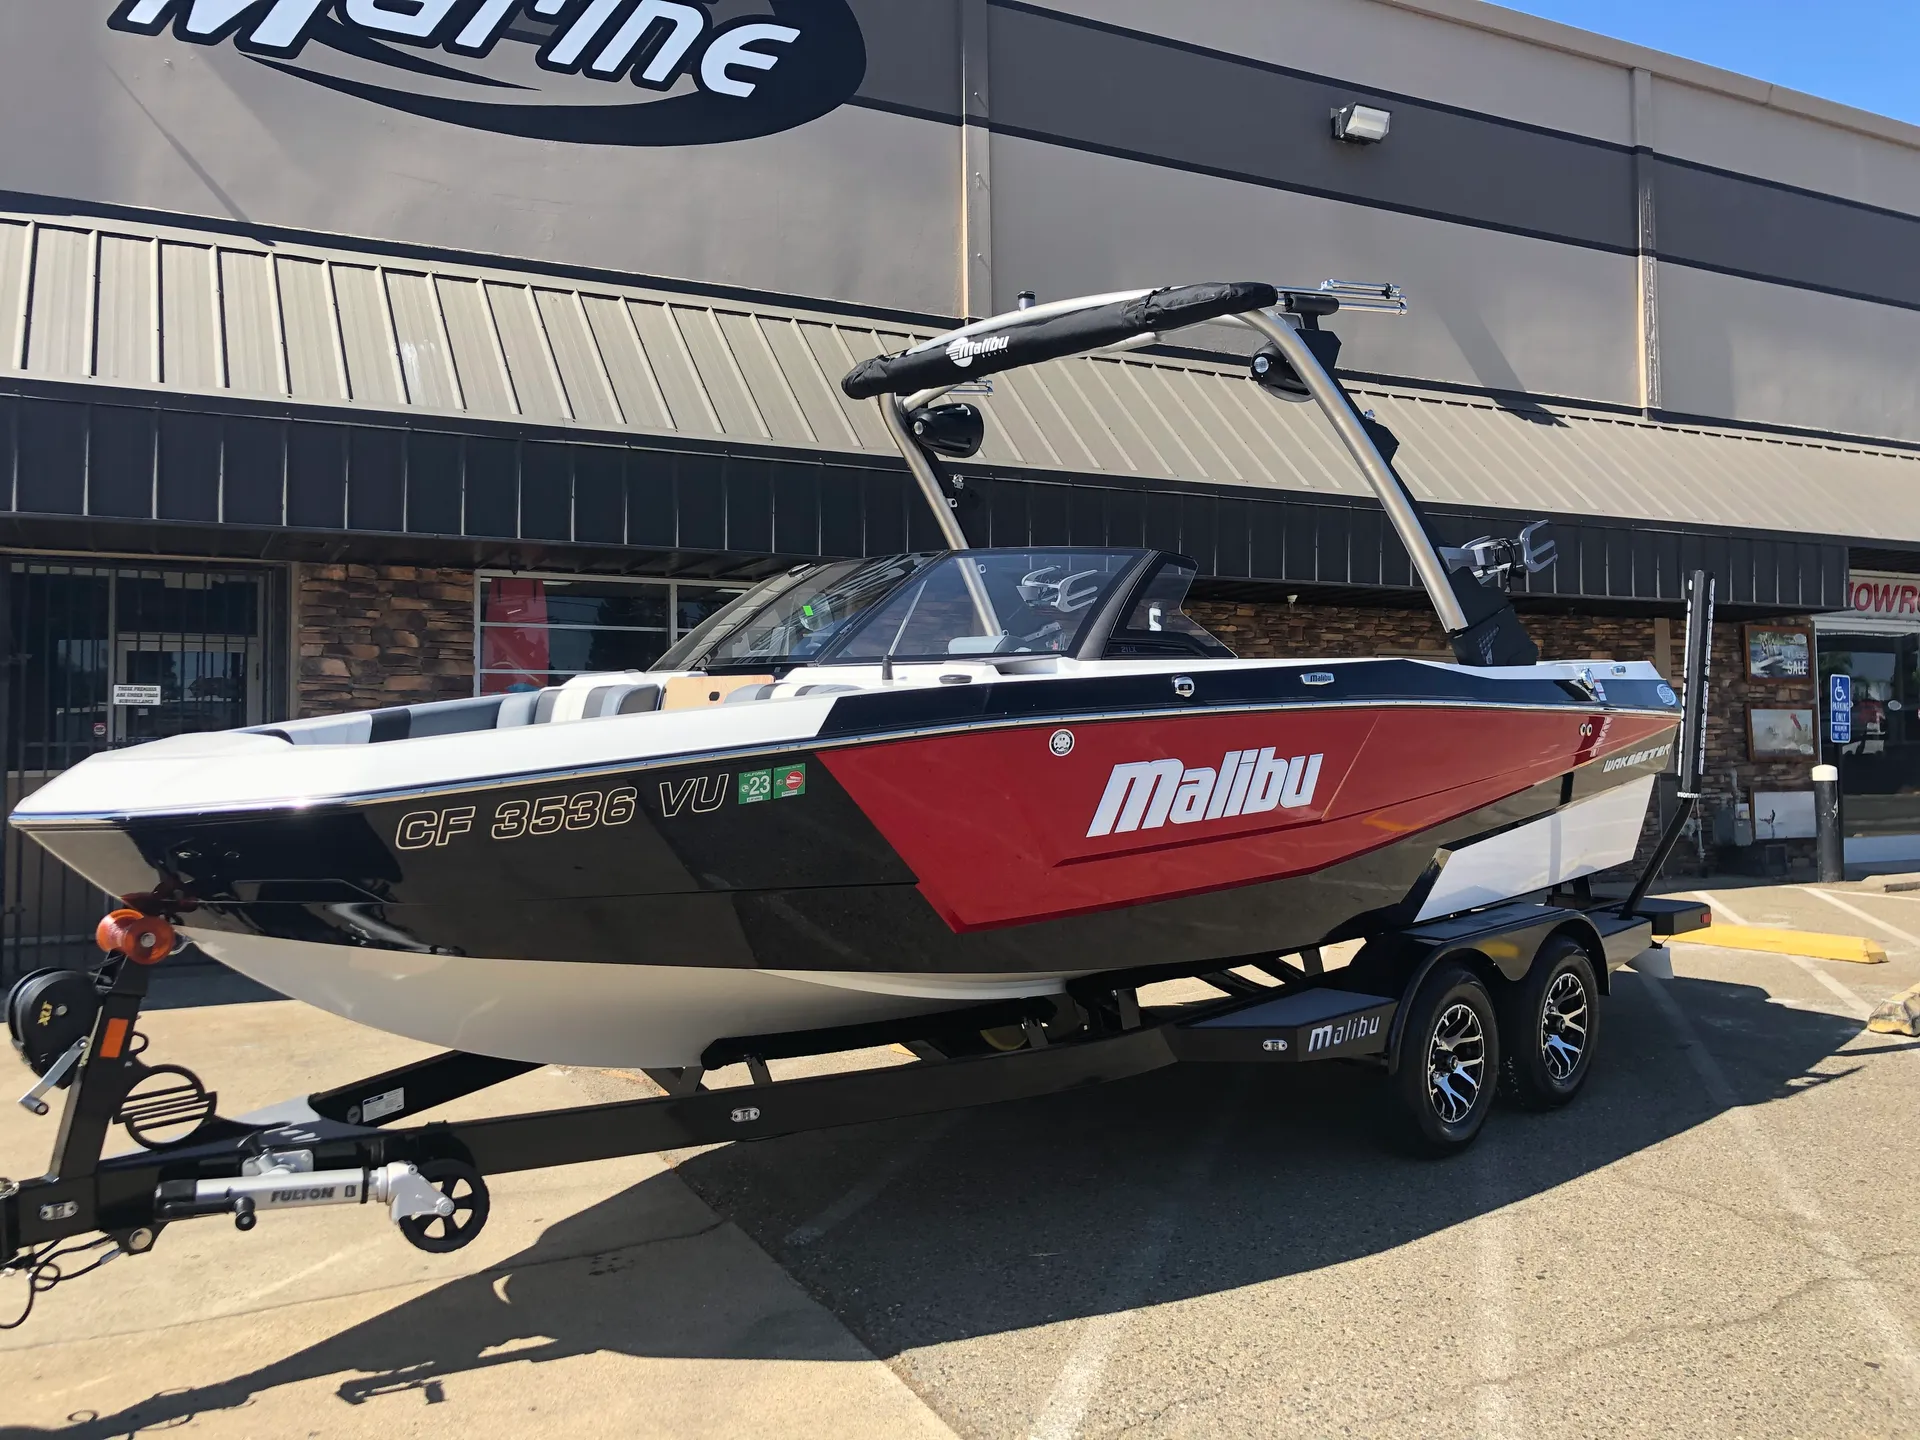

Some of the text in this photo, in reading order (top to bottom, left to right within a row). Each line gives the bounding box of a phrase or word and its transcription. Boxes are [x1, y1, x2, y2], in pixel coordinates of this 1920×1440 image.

[958, 336, 1010, 359] Malibu
[1848, 582, 1920, 613] OWR
[1787, 660, 1807, 675] SALE
[1832, 701, 1849, 712] PARKING
[1835, 712, 1846, 722] ONLY
[744, 770, 767, 778] CALIFORNIA
[749, 775, 771, 796] 23
[1086, 747, 1324, 838] Malibu
[395, 773, 729, 850] CF 3536 VU
[1308, 1016, 1381, 1052] Malibu
[271, 1186, 336, 1203] FULTON
